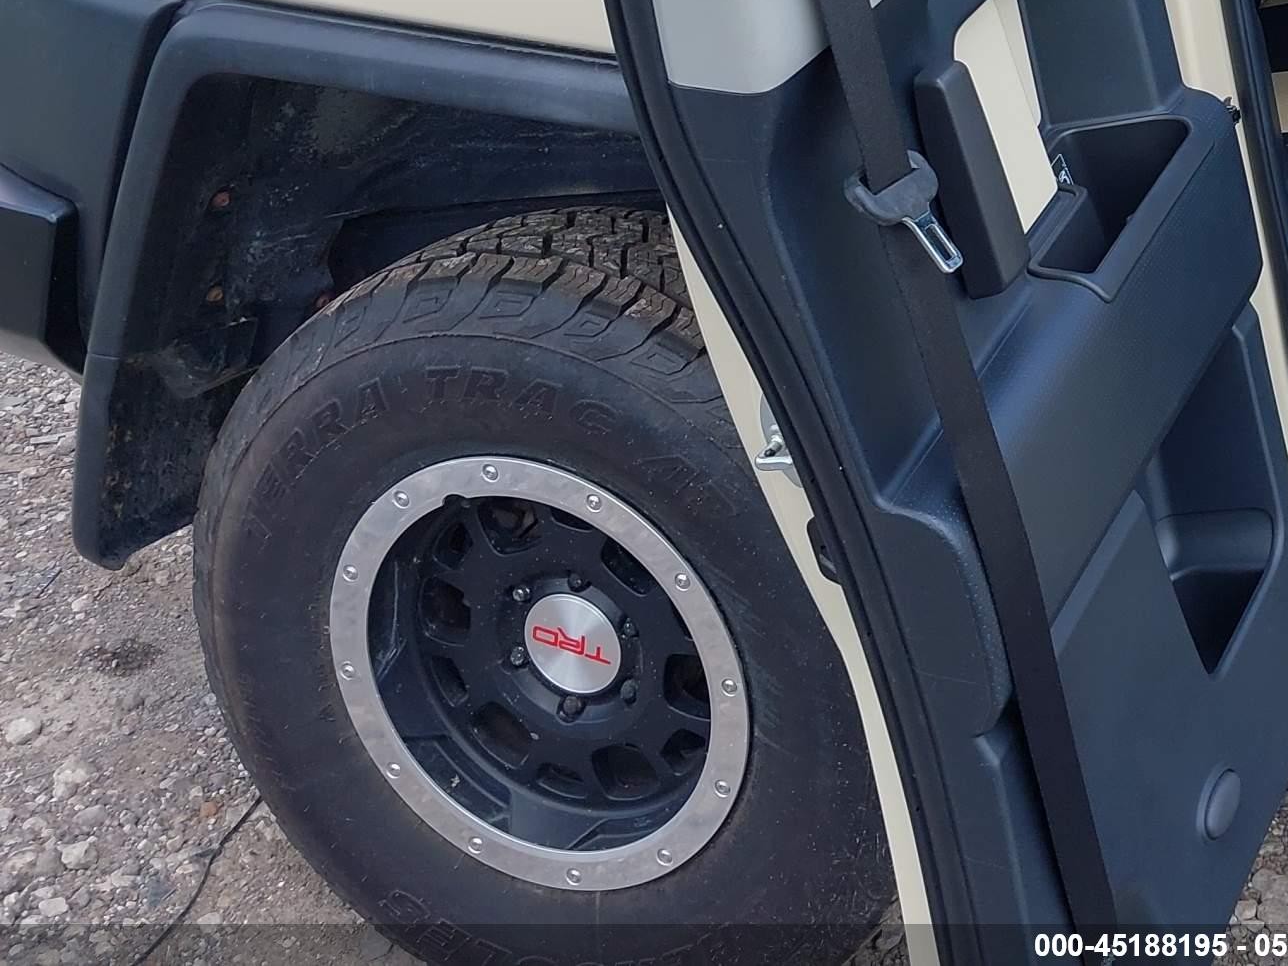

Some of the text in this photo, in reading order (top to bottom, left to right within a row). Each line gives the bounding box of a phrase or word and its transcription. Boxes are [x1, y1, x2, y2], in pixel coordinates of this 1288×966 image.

[246, 377, 391, 540] TERRA
[424, 365, 621, 435] TRAC
[533, 626, 611, 665] TRD
